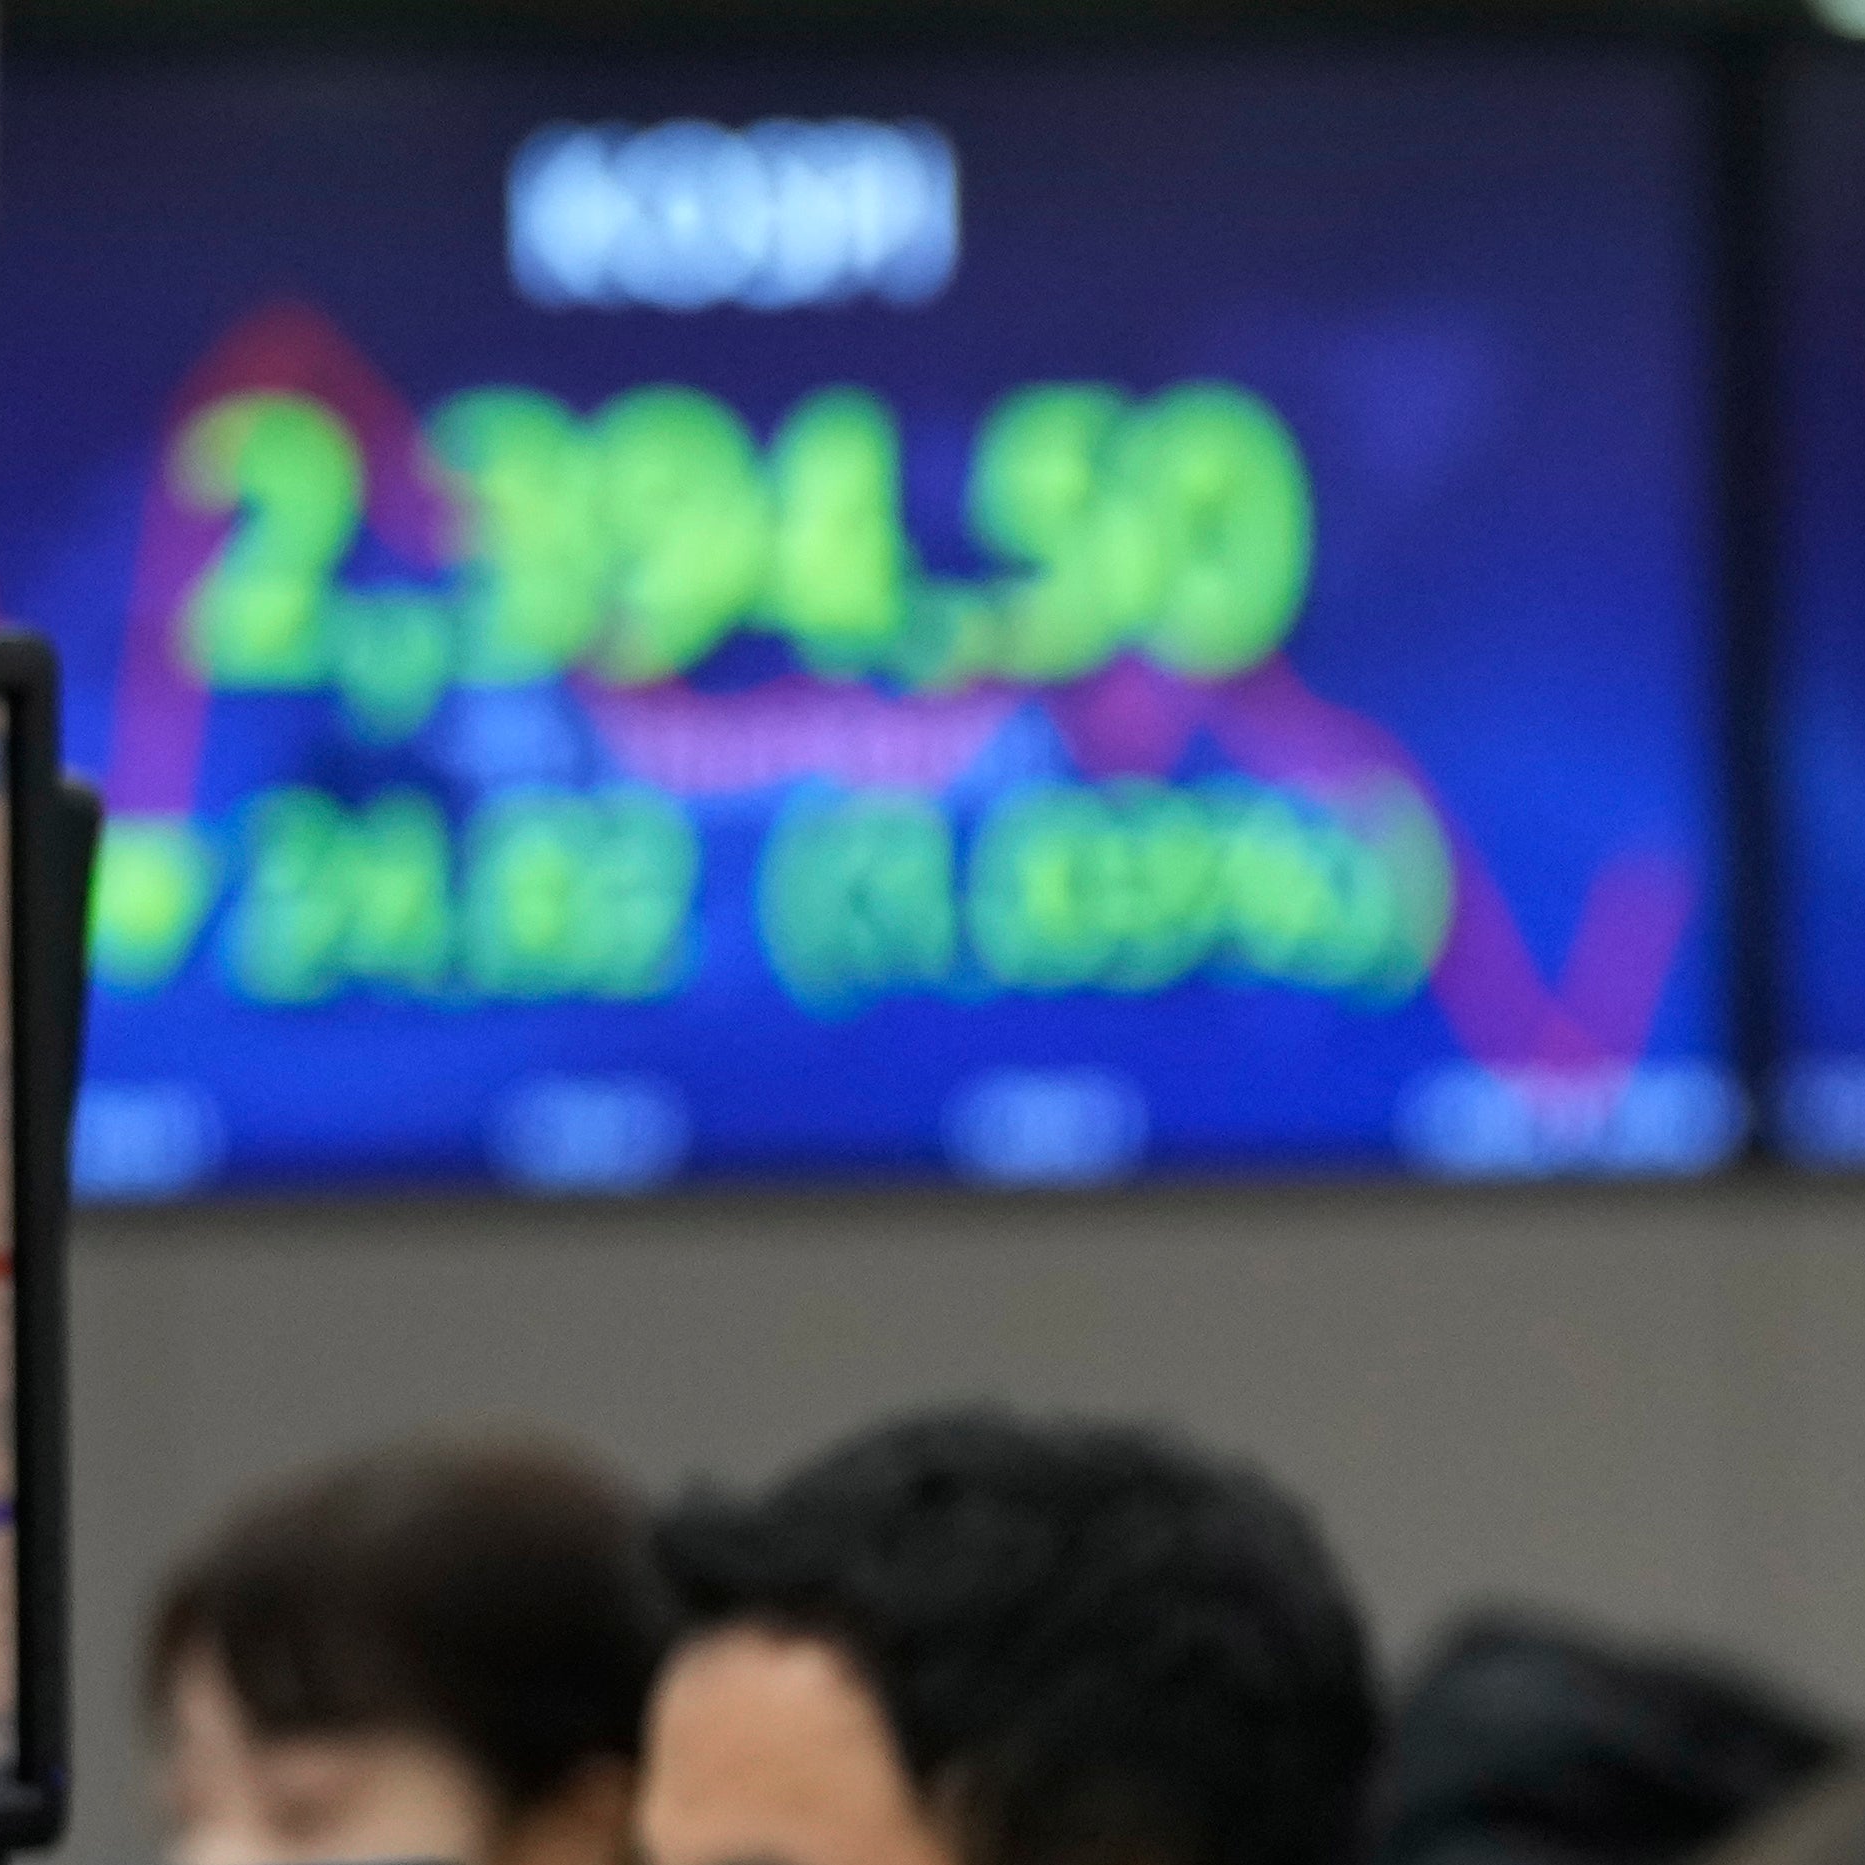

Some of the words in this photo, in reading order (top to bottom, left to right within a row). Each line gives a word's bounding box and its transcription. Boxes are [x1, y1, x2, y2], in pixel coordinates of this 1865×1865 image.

[511, 119, 961, 306] KOSPI
[175, 382, 1313, 738] 2,394.50
[227, 784, 699, 1002] 24.82
